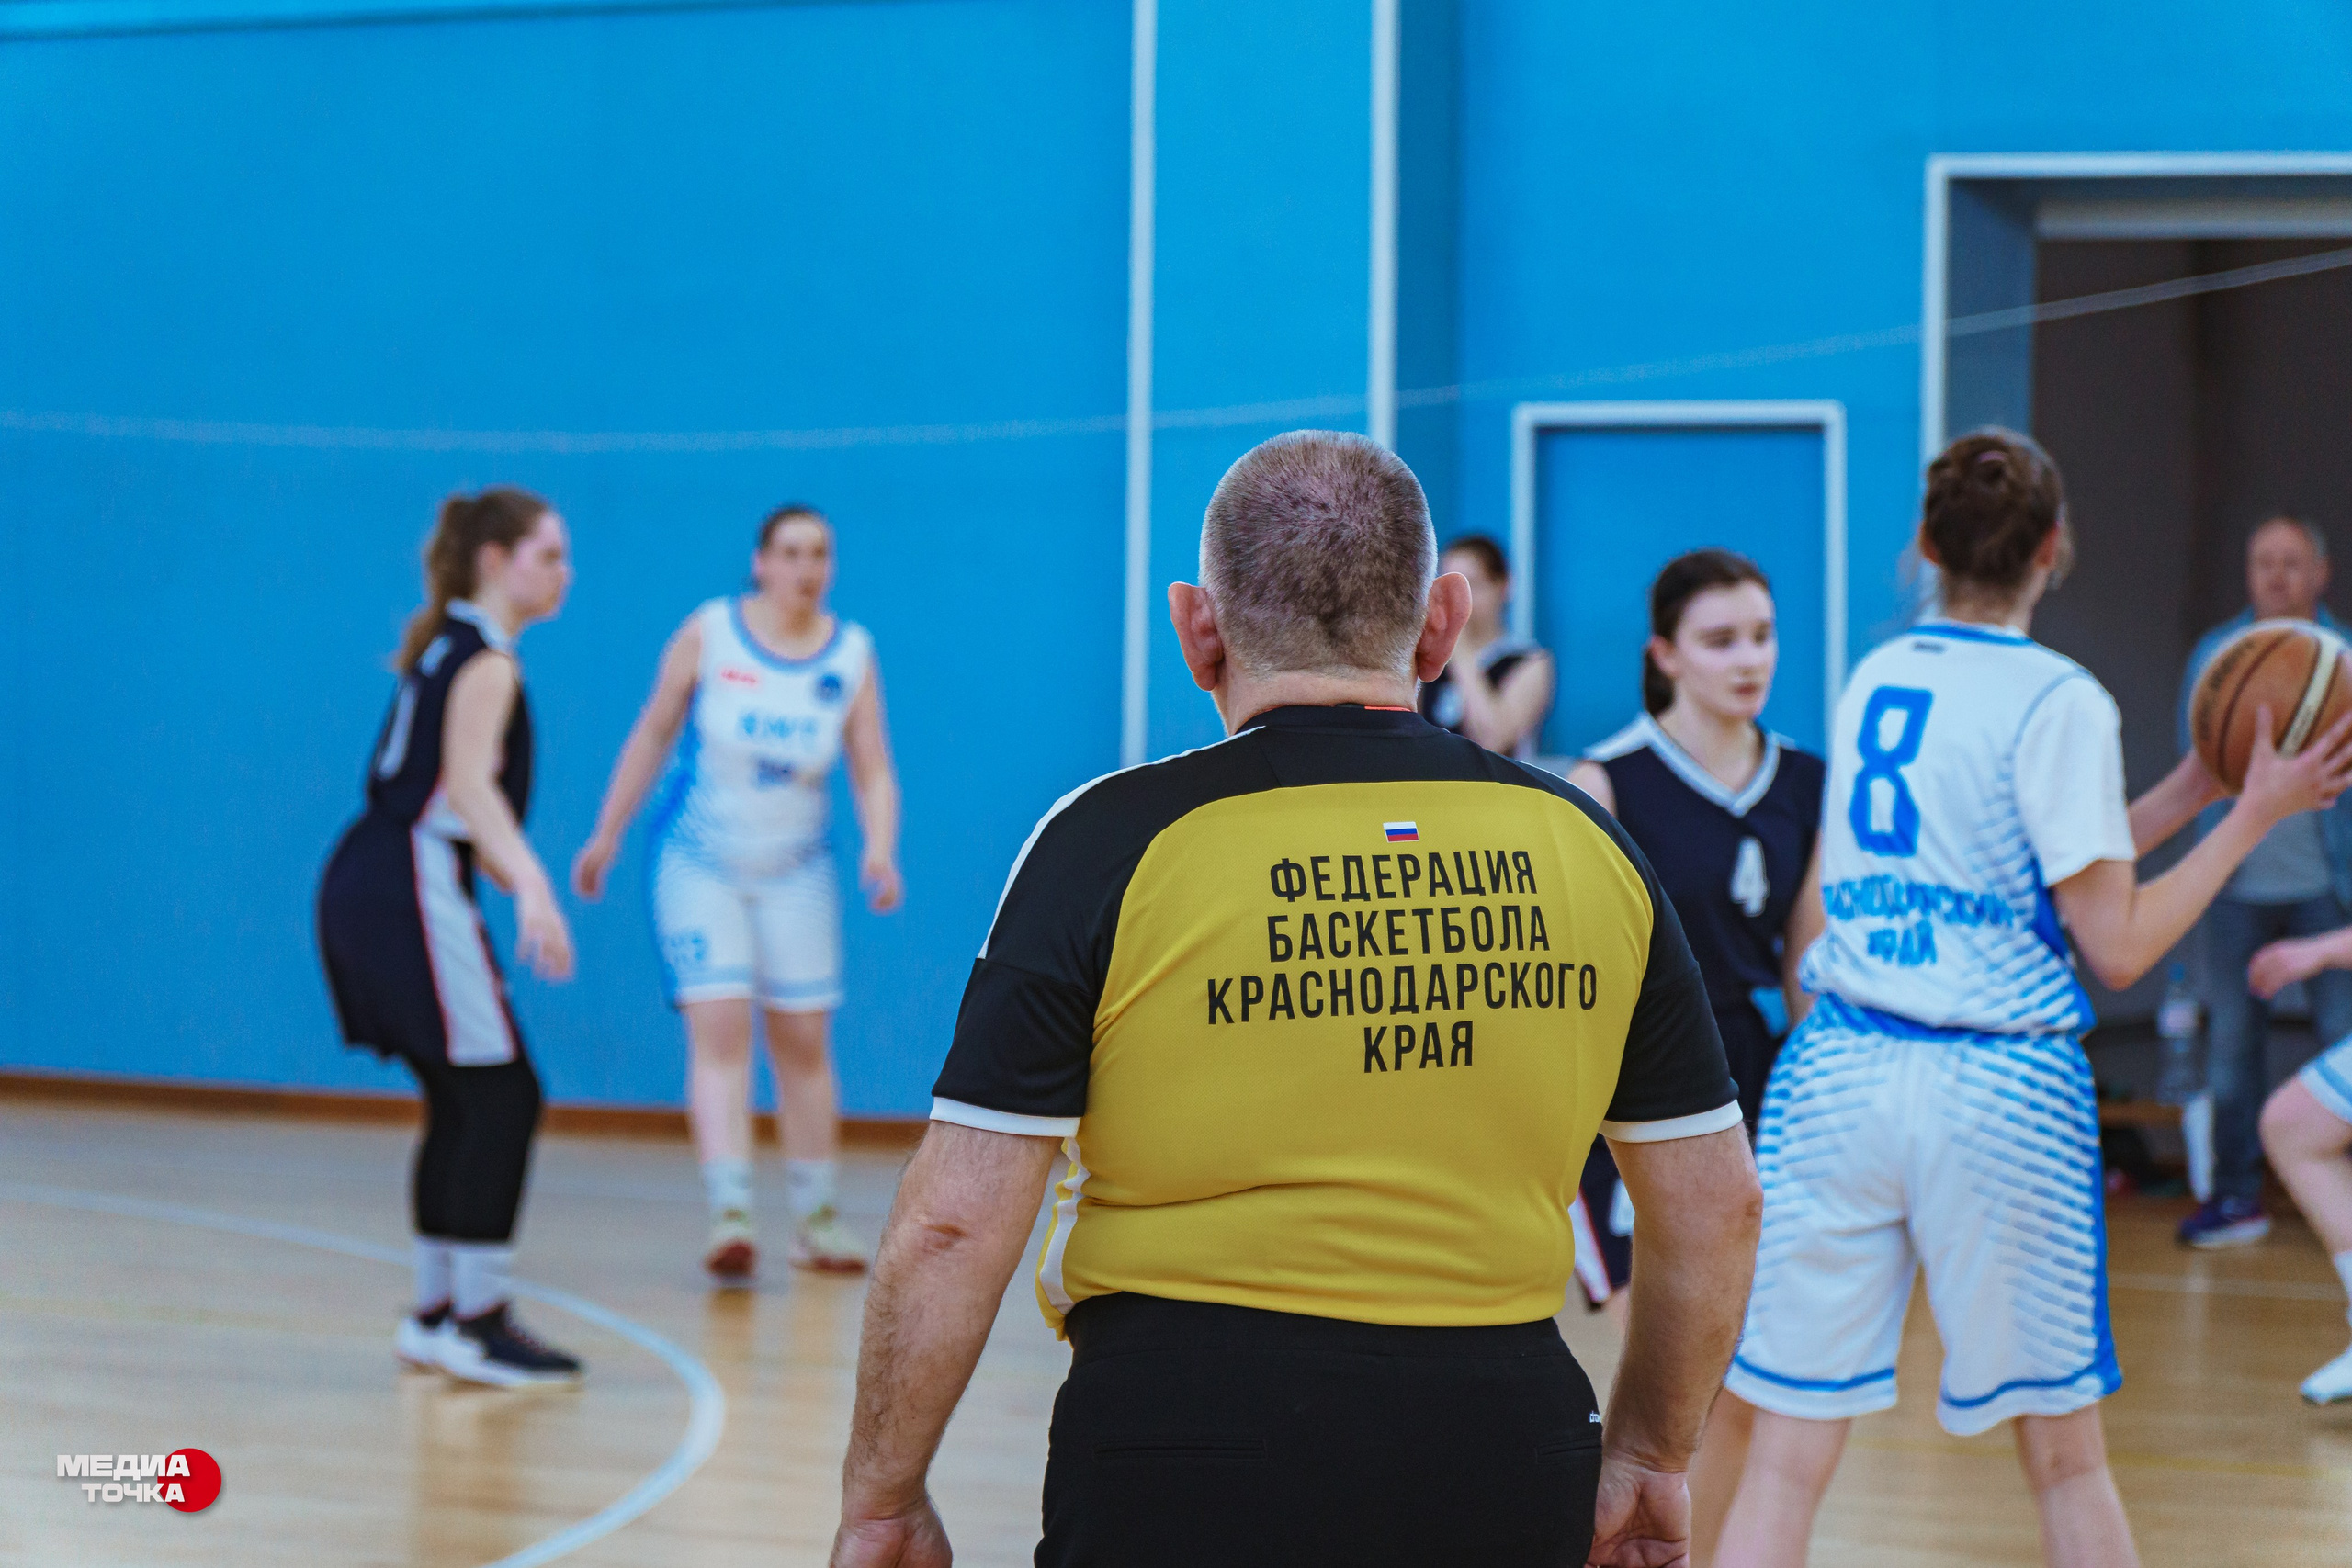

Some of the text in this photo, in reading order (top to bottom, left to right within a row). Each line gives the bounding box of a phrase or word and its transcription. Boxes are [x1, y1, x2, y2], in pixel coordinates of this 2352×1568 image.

[1849, 685, 1933, 857] 8
[1270, 850, 1538, 903] ФЕДЕРАЦИЯ
[1730, 837, 1770, 918] 4
[1267, 905, 1551, 963] БАСКЕТБОЛА
[1207, 961, 1597, 1025] КРАСНОДАРСКОГО
[1363, 1020, 1474, 1074] КРАЯ
